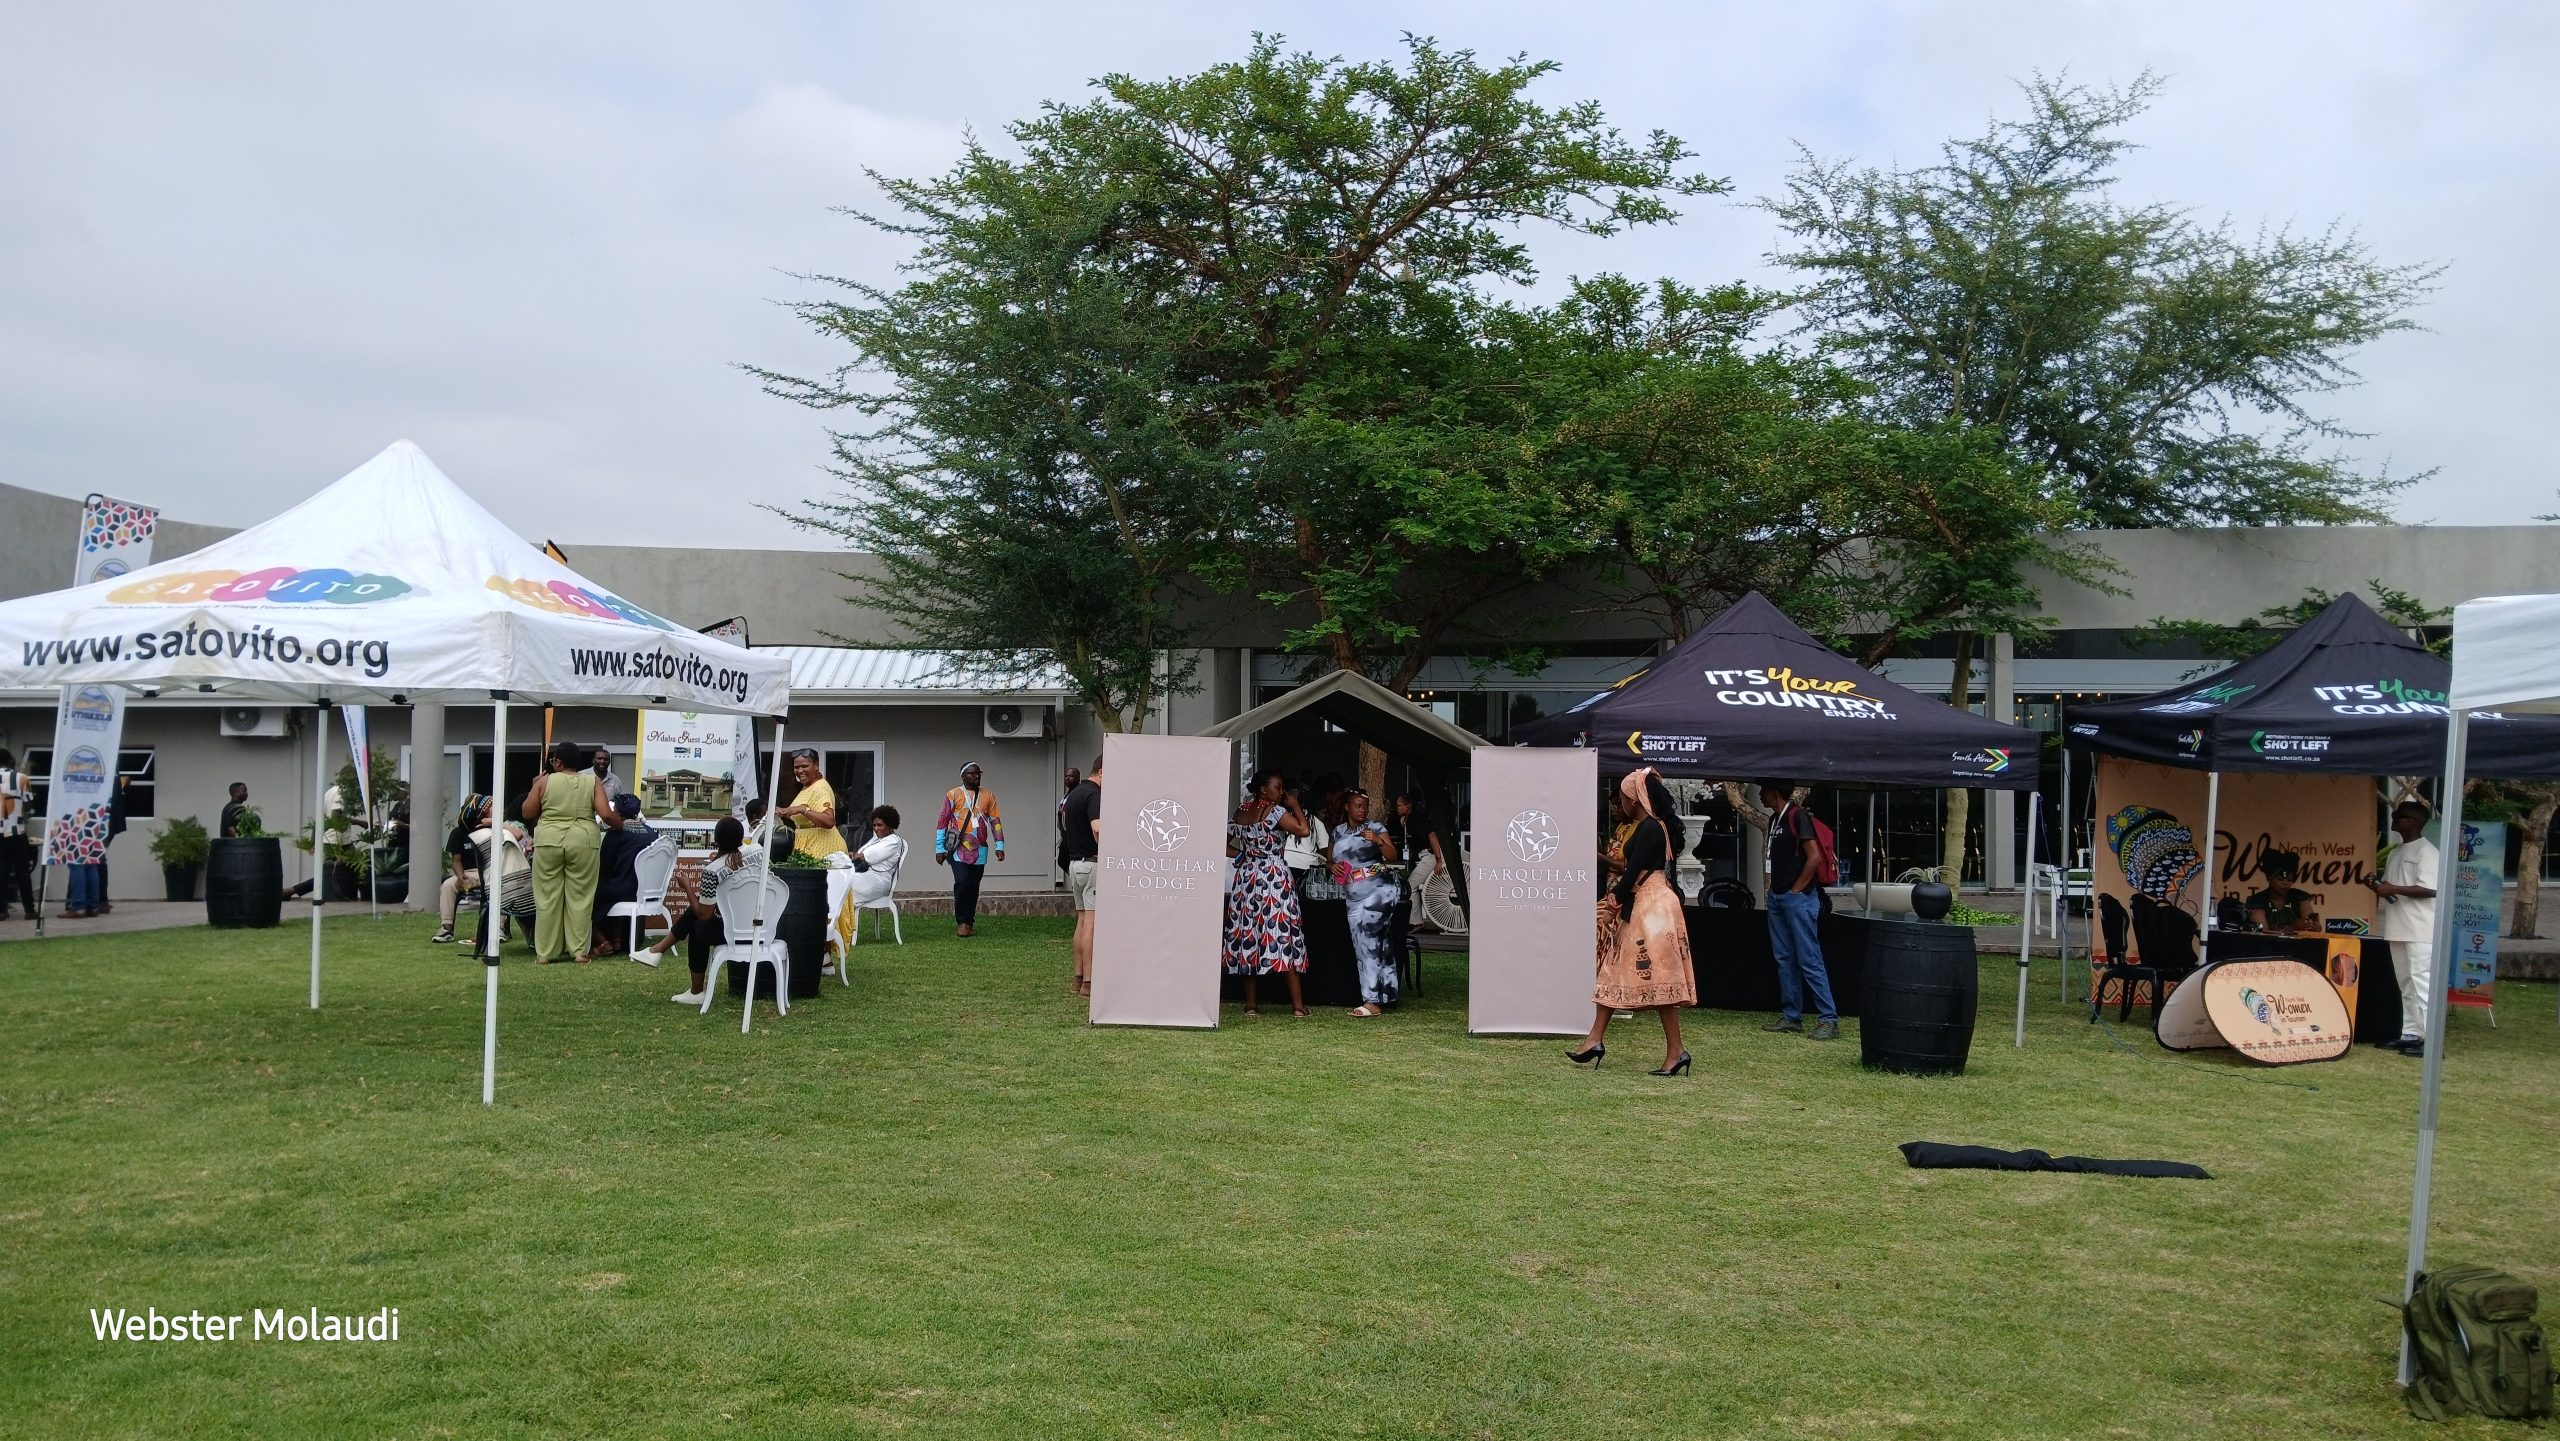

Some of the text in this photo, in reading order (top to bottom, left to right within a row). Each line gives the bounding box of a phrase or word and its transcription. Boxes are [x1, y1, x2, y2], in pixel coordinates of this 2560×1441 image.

[136, 578, 382, 596] SATOVITO
[23, 621, 389, 678] www.satovito.org
[570, 647, 749, 703] www.satovito.org
[1704, 669, 1769, 686] IT'S
[2313, 678, 2450, 704] IT'S You
[1716, 690, 1885, 714] COUNTRY
[1823, 709, 1898, 721] ENJOY IT
[647, 730, 729, 746] Ndaba Guest Lodge
[1641, 740, 1706, 752] SHO'T LEFT
[2263, 740, 2330, 751] SHO'T LEFT
[1951, 751, 1994, 763] South Africa
[2322, 842, 2356, 857] West
[1105, 856, 1217, 873] FARQUHAR
[2205, 830, 2365, 886] Wmen
[1126, 875, 1196, 890] LODGE
[1478, 867, 1590, 883] FARQUHAR
[1499, 886, 1568, 900] LODGE
[2266, 994, 2313, 1015] Women
